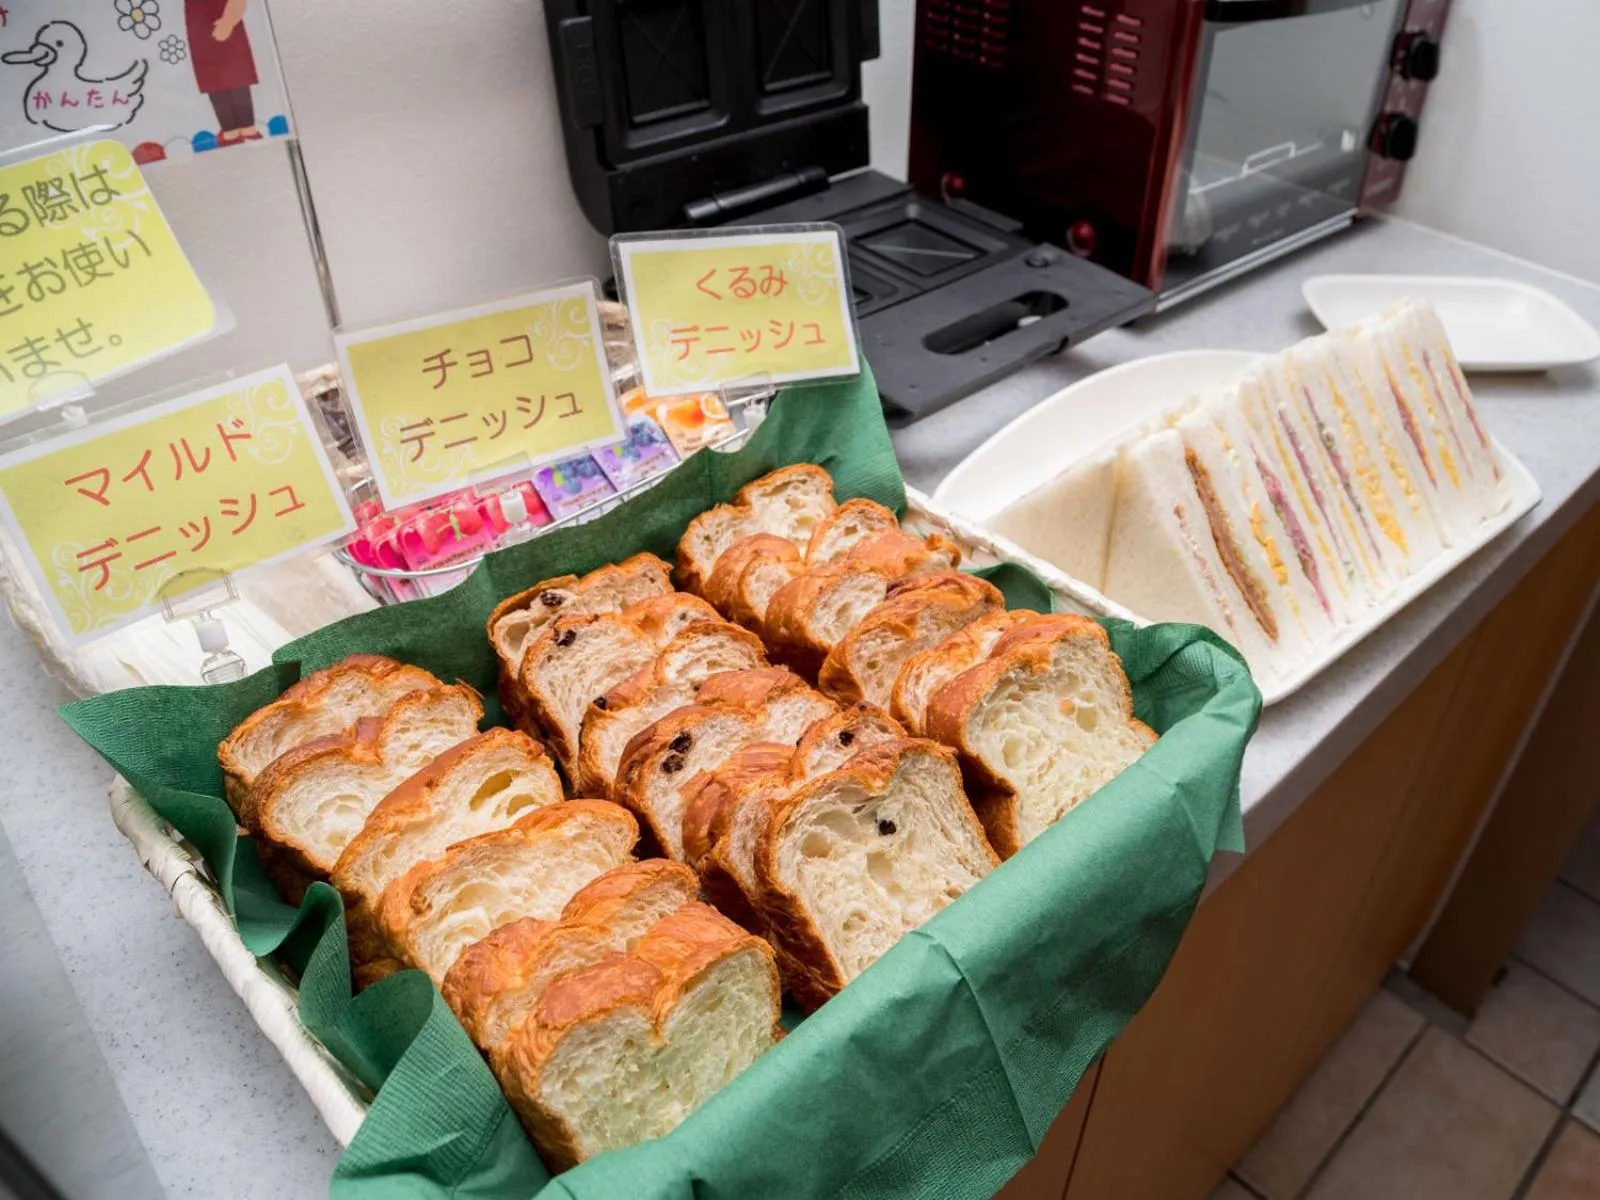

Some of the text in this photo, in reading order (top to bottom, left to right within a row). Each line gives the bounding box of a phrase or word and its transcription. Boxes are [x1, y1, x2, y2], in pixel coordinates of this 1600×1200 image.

[32, 89, 129, 109] かんたん
[696, 264, 788, 300] くるみ
[422, 334, 534, 390] チョコ
[670, 319, 827, 361] デニッシュ
[400, 392, 584, 463] デニッシュ
[65, 417, 252, 506] マイルド
[76, 485, 305, 590] デニッシュ
